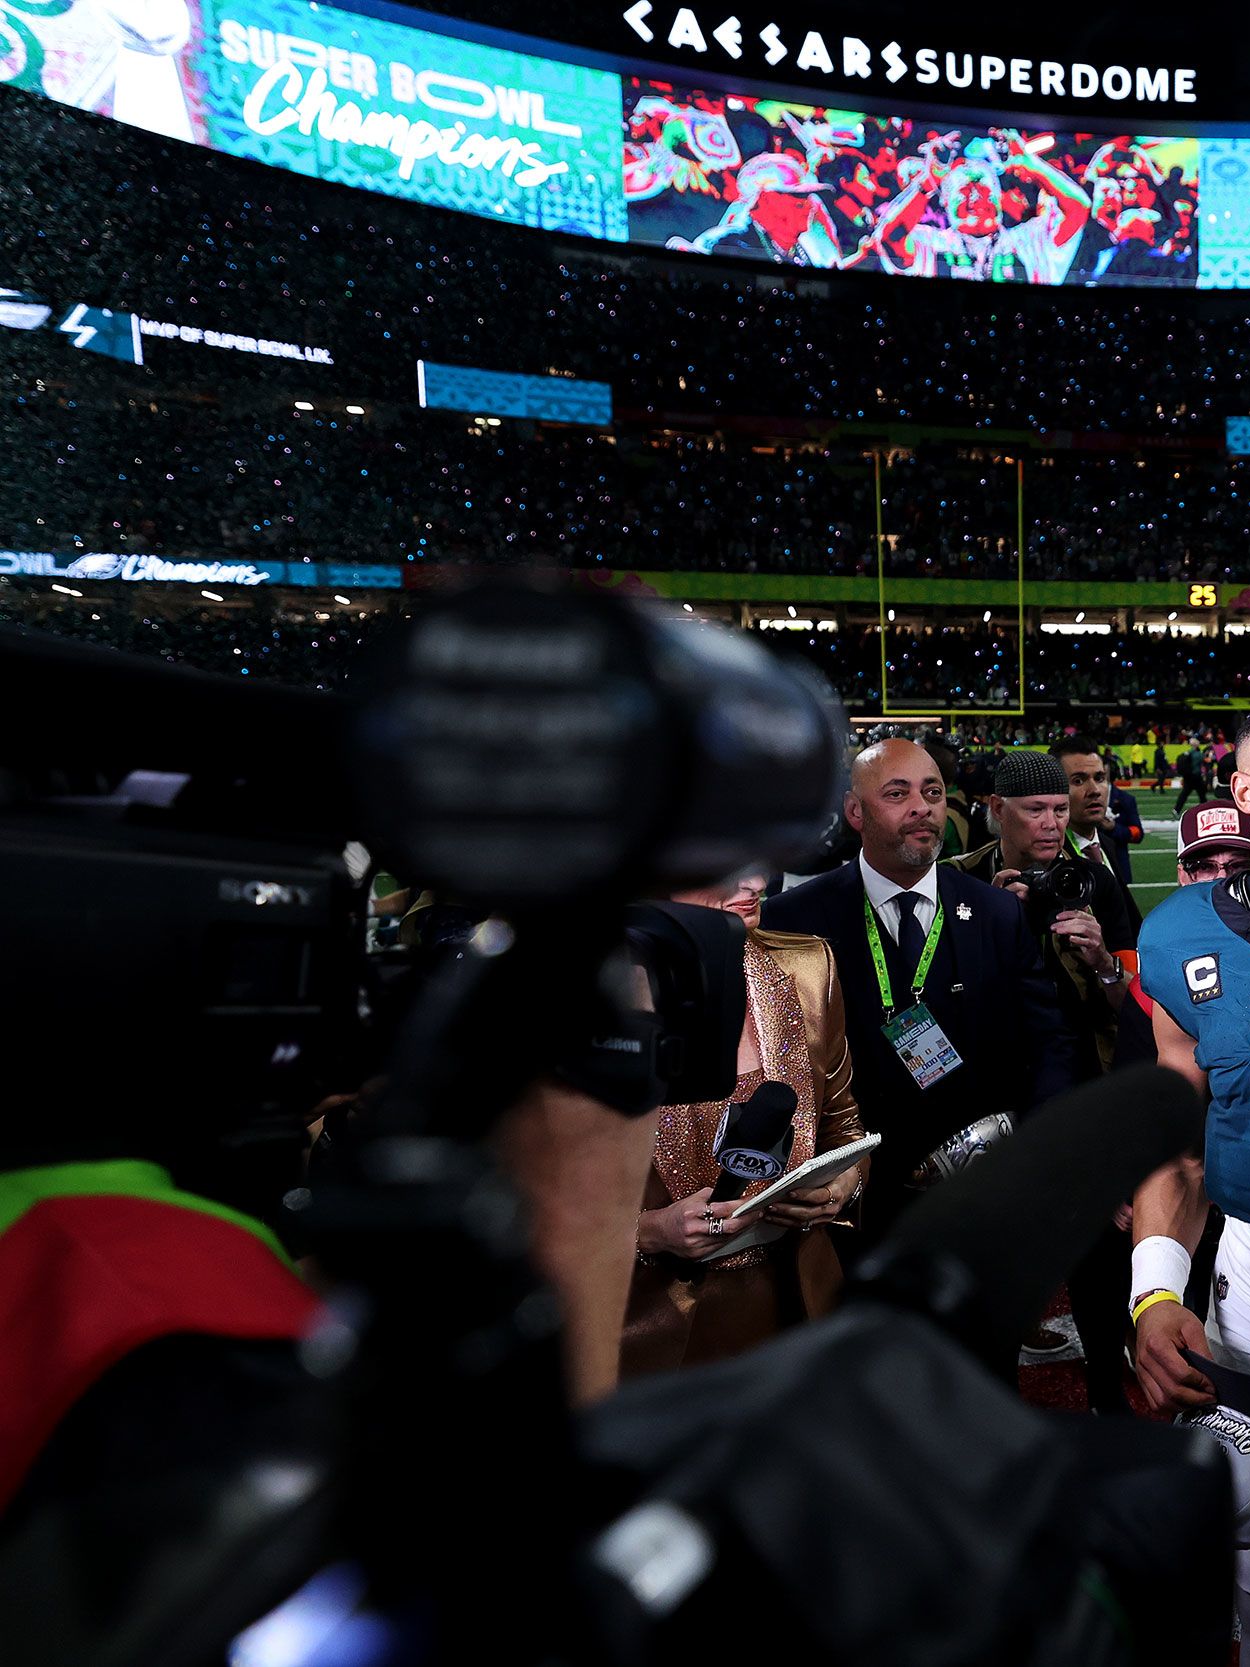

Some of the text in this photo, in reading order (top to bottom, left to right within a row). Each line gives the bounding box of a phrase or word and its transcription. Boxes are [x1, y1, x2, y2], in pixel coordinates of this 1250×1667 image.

[622, 0, 1198, 103] CAESARS SUPERDOME
[218, 18, 583, 139] SUPER BOWL
[243, 58, 570, 188] Champions
[140, 318, 180, 339] MVP
[203, 329, 259, 353] SUPER
[258, 338, 306, 361] BOWL
[121, 553, 271, 586] Champions
[1190, 584, 1217, 606] 25
[1185, 956, 1218, 992] C
[893, 1017, 934, 1050] GAMEDAY
[730, 1152, 773, 1174] FOX
